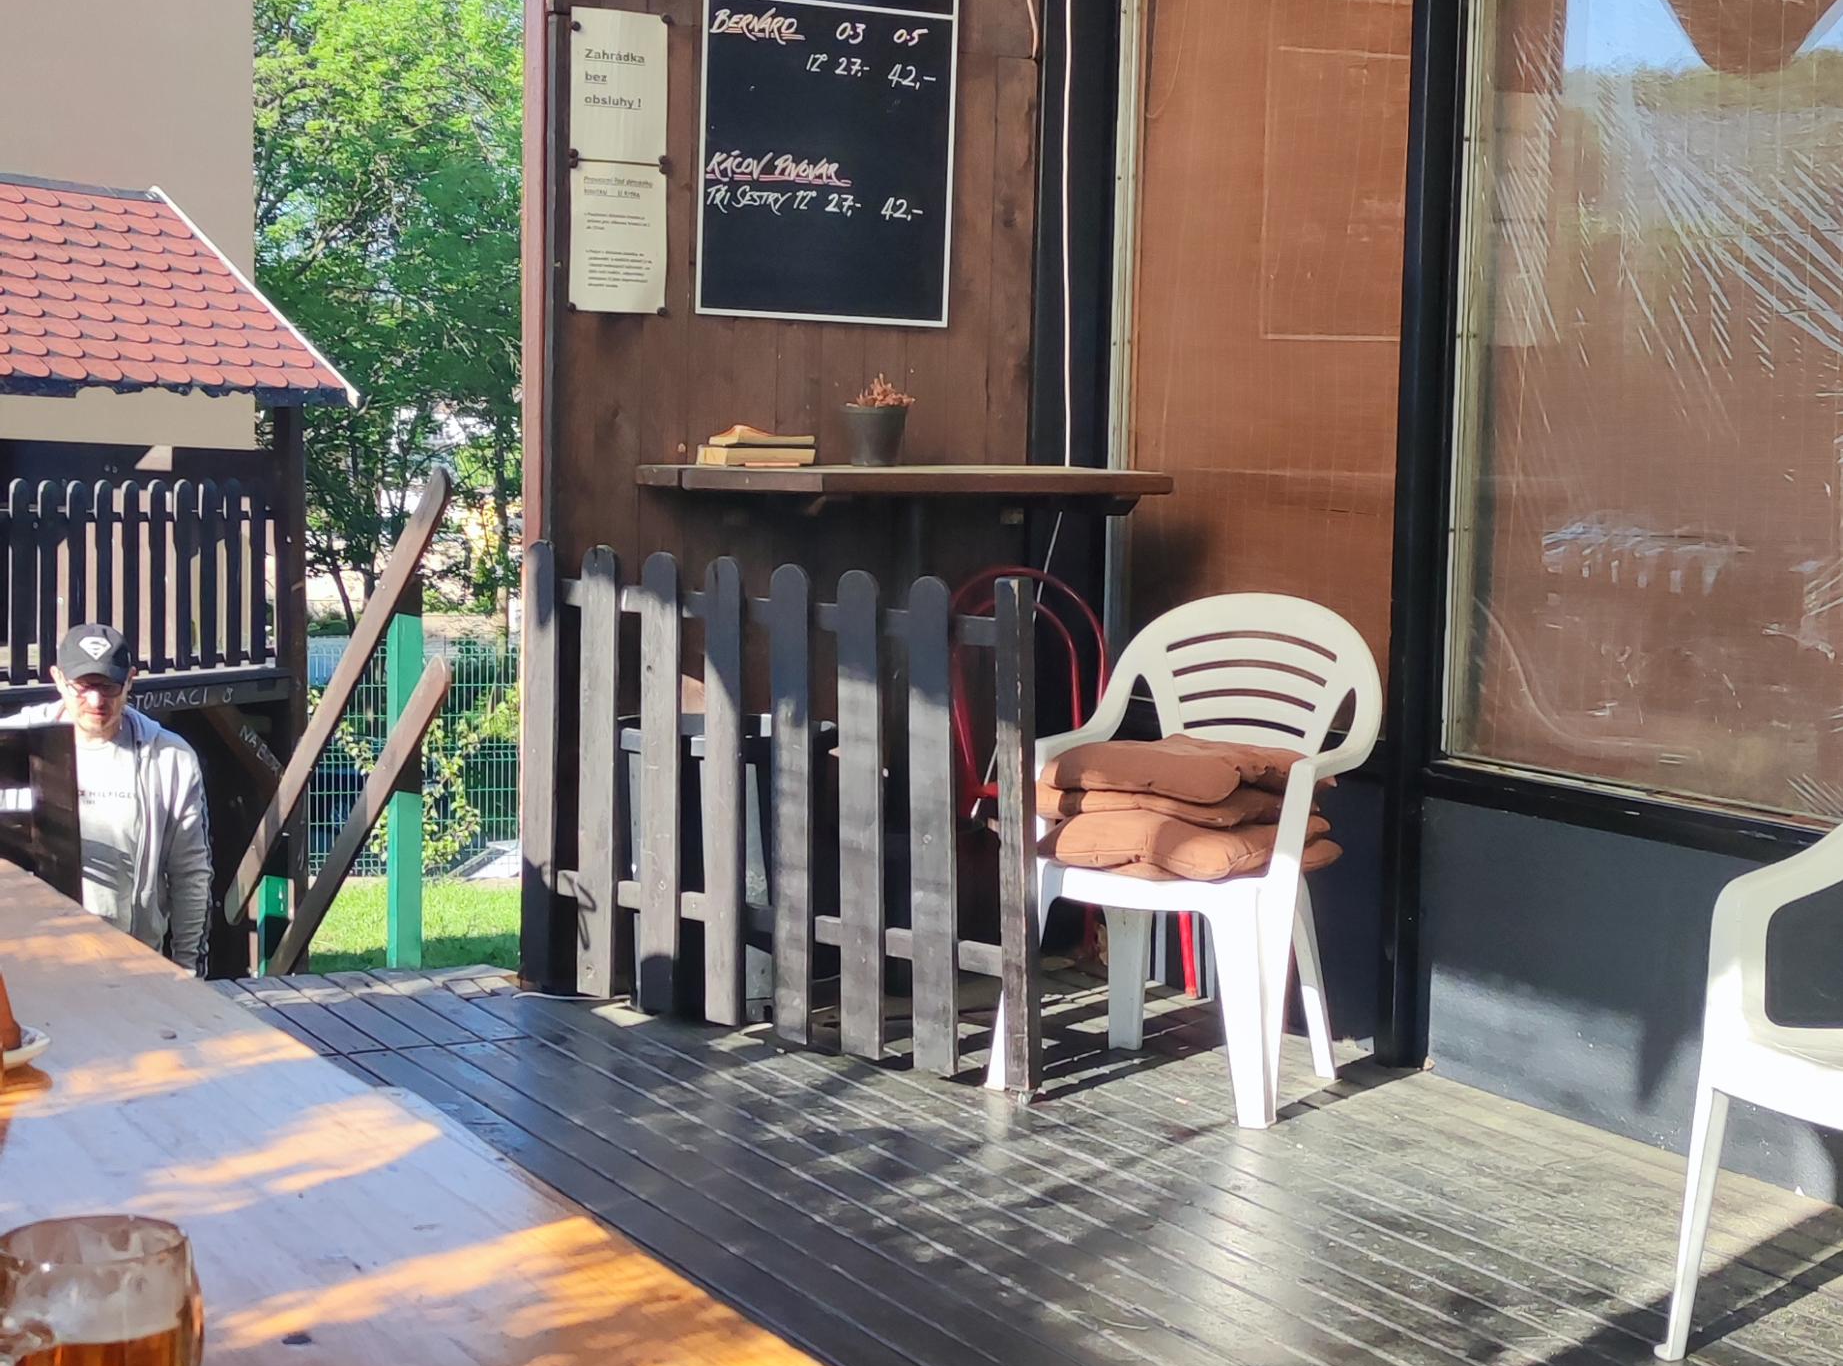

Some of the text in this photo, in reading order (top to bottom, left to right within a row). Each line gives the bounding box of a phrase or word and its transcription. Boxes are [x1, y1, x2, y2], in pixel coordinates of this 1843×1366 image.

[710, 8, 801, 44] BERNARD
[584, 48, 646, 64] Zahrádka
[584, 71, 608, 83] bez
[584, 94, 634, 109] obsluhy
